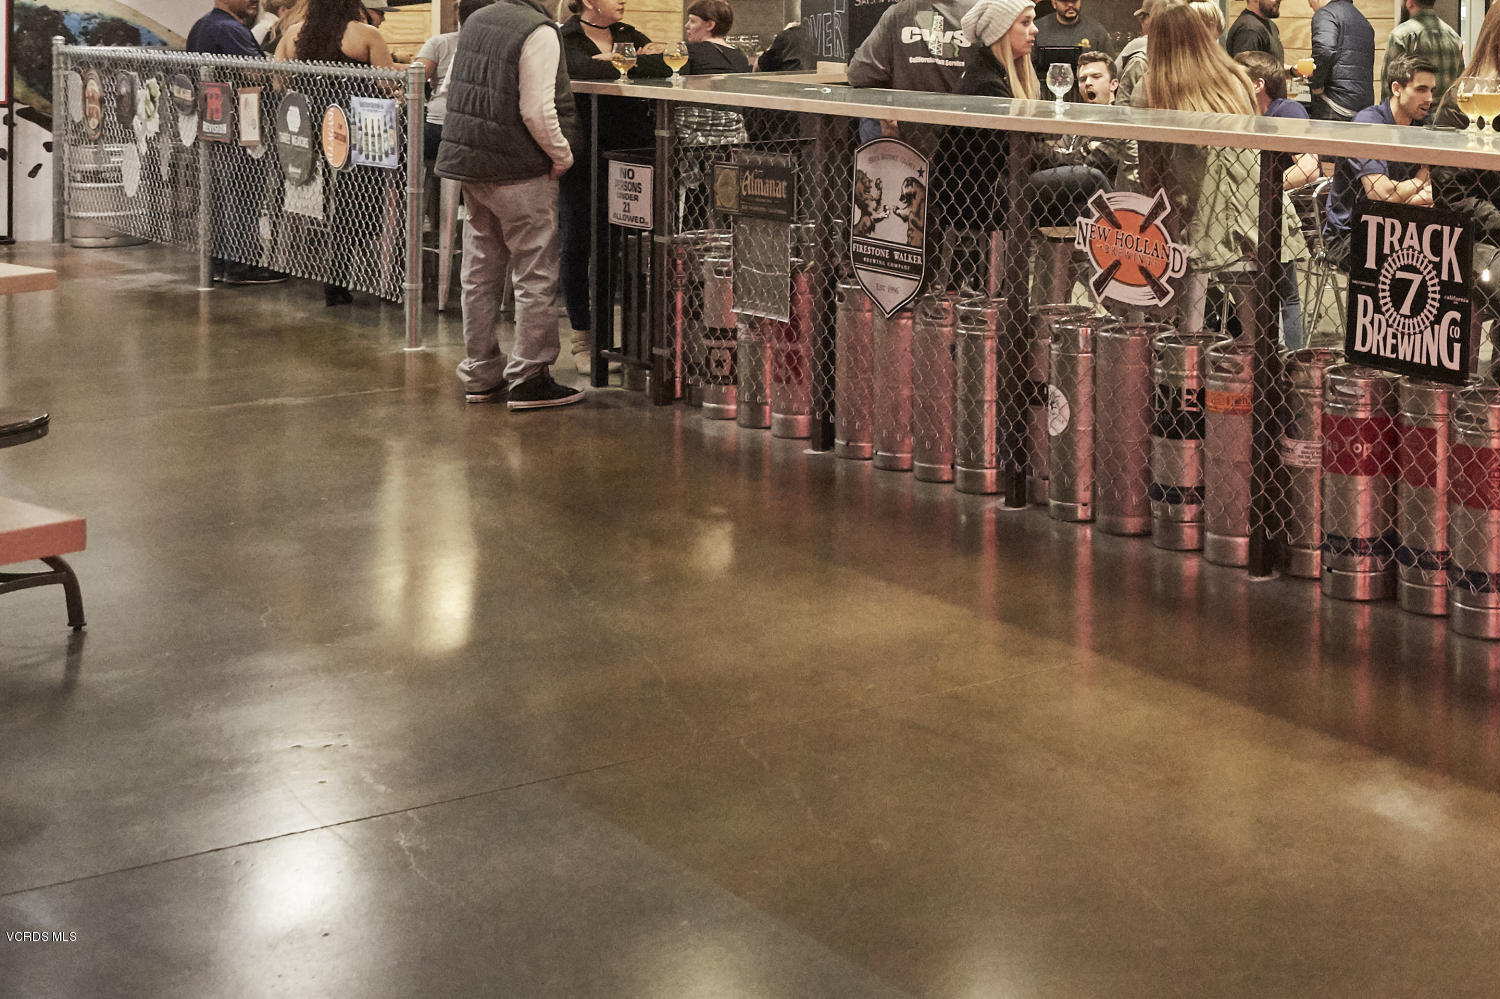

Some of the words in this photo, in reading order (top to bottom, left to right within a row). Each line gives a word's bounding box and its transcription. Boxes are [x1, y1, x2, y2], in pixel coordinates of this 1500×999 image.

[620, 167, 635, 180] NO
[622, 201, 631, 214] 21
[613, 212, 646, 225] ALLOWED
[852, 243, 890, 259] FIRESTONE
[893, 250, 922, 265] WALKER
[1077, 221, 1111, 248] NEW
[1114, 230, 1183, 273] HOLLAND
[1361, 213, 1464, 283] TRACK
[863, 256, 886, 267] BREWING
[887, 261, 910, 271] COMPANY
[1395, 271, 1425, 316] 7
[1354, 293, 1462, 371] BREWING
[1450, 324, 1460, 339] CO
